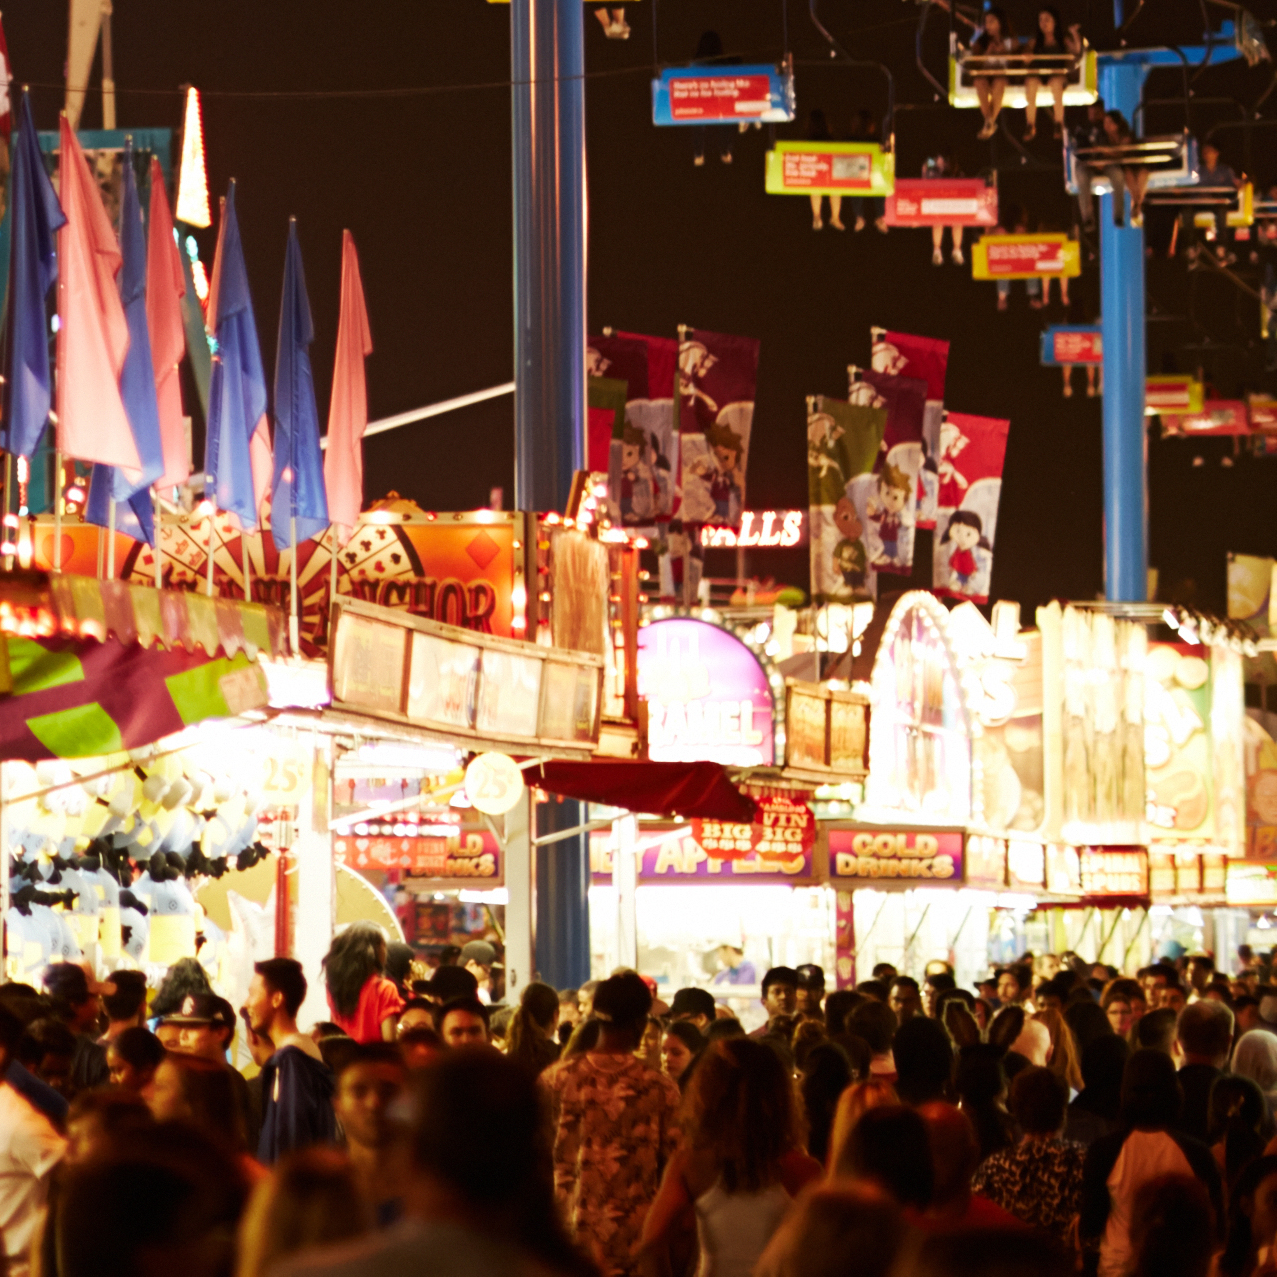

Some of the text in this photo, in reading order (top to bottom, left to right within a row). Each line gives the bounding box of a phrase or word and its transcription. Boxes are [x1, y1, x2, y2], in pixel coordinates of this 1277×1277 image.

[701, 823, 753, 840] BIG
[762, 827, 804, 842] BIG
[852, 833, 939, 858] COLD
[836, 852, 955, 878] DRINKS
